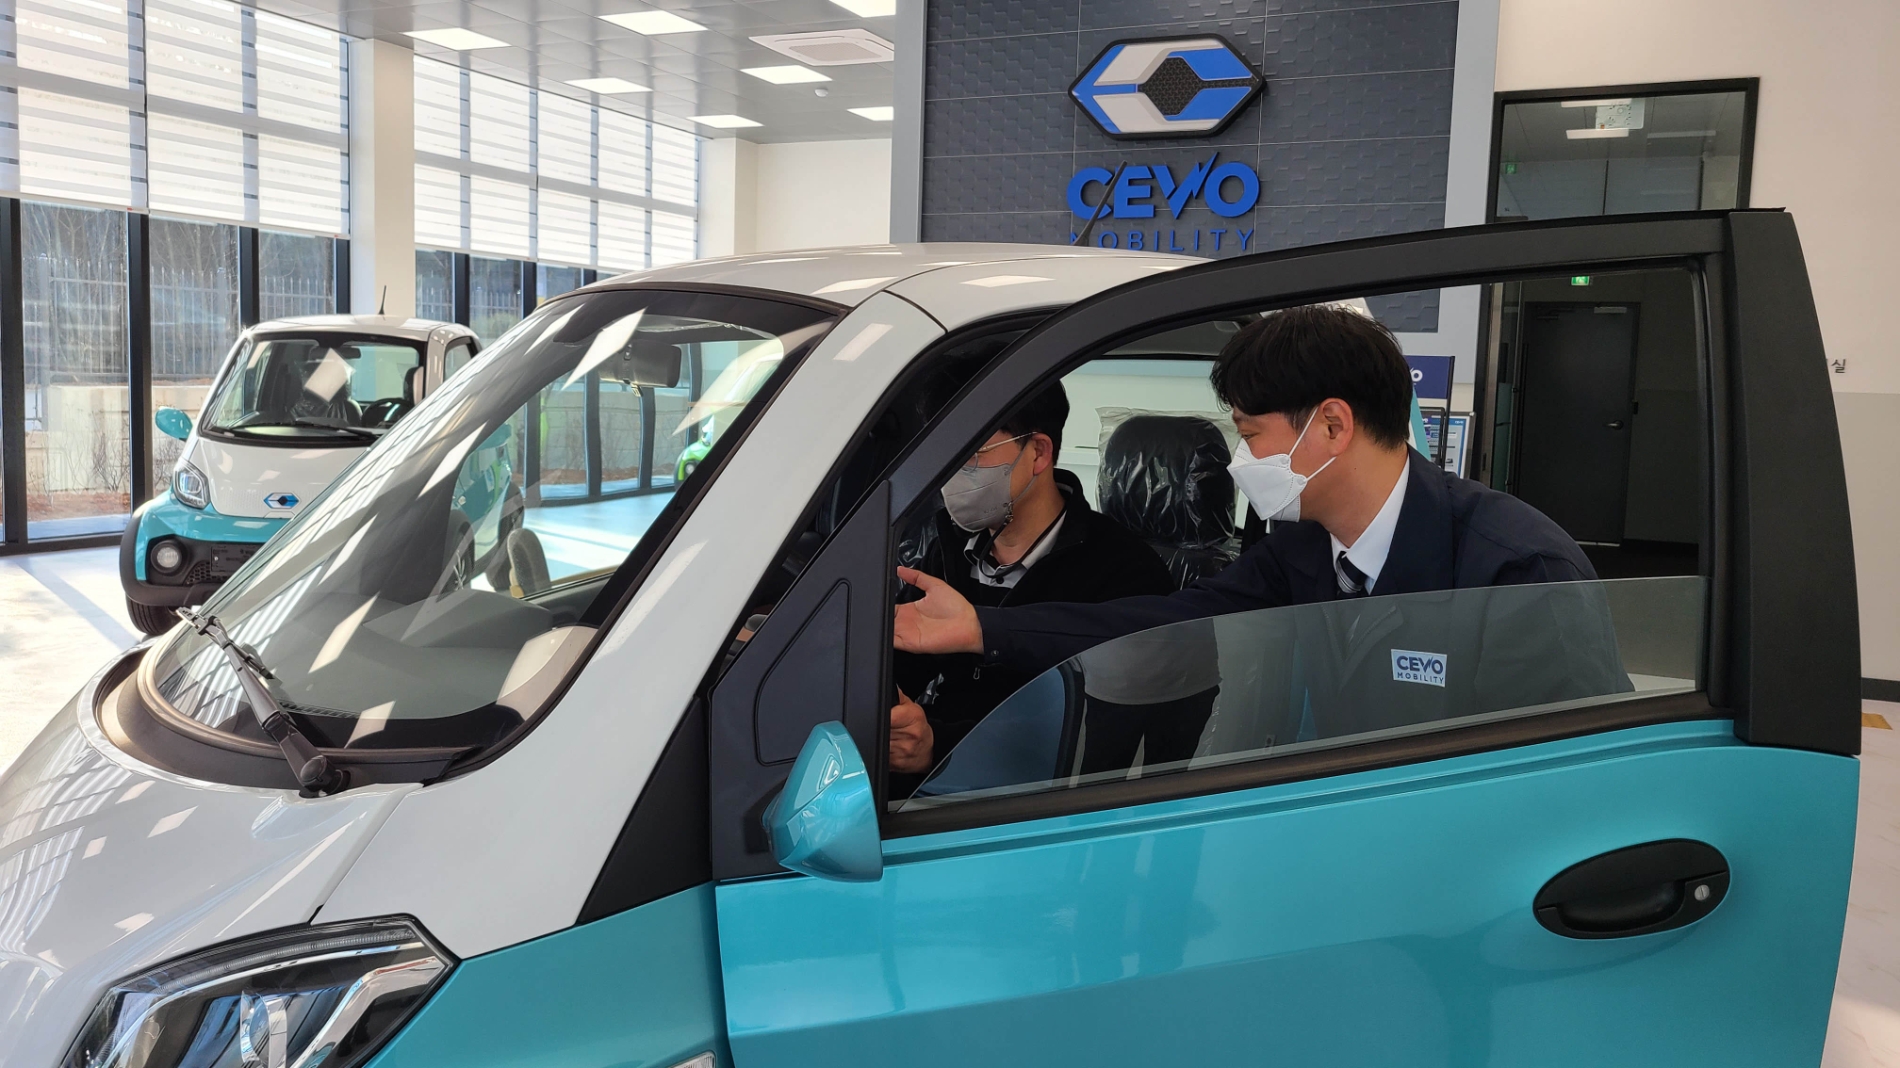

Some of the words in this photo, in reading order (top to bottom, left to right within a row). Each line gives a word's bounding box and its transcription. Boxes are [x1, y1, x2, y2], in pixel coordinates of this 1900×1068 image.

[1068, 152, 1260, 219] CEVO
[1396, 656, 1443, 674] CEVO
[1397, 672, 1444, 684] MOBILITY
